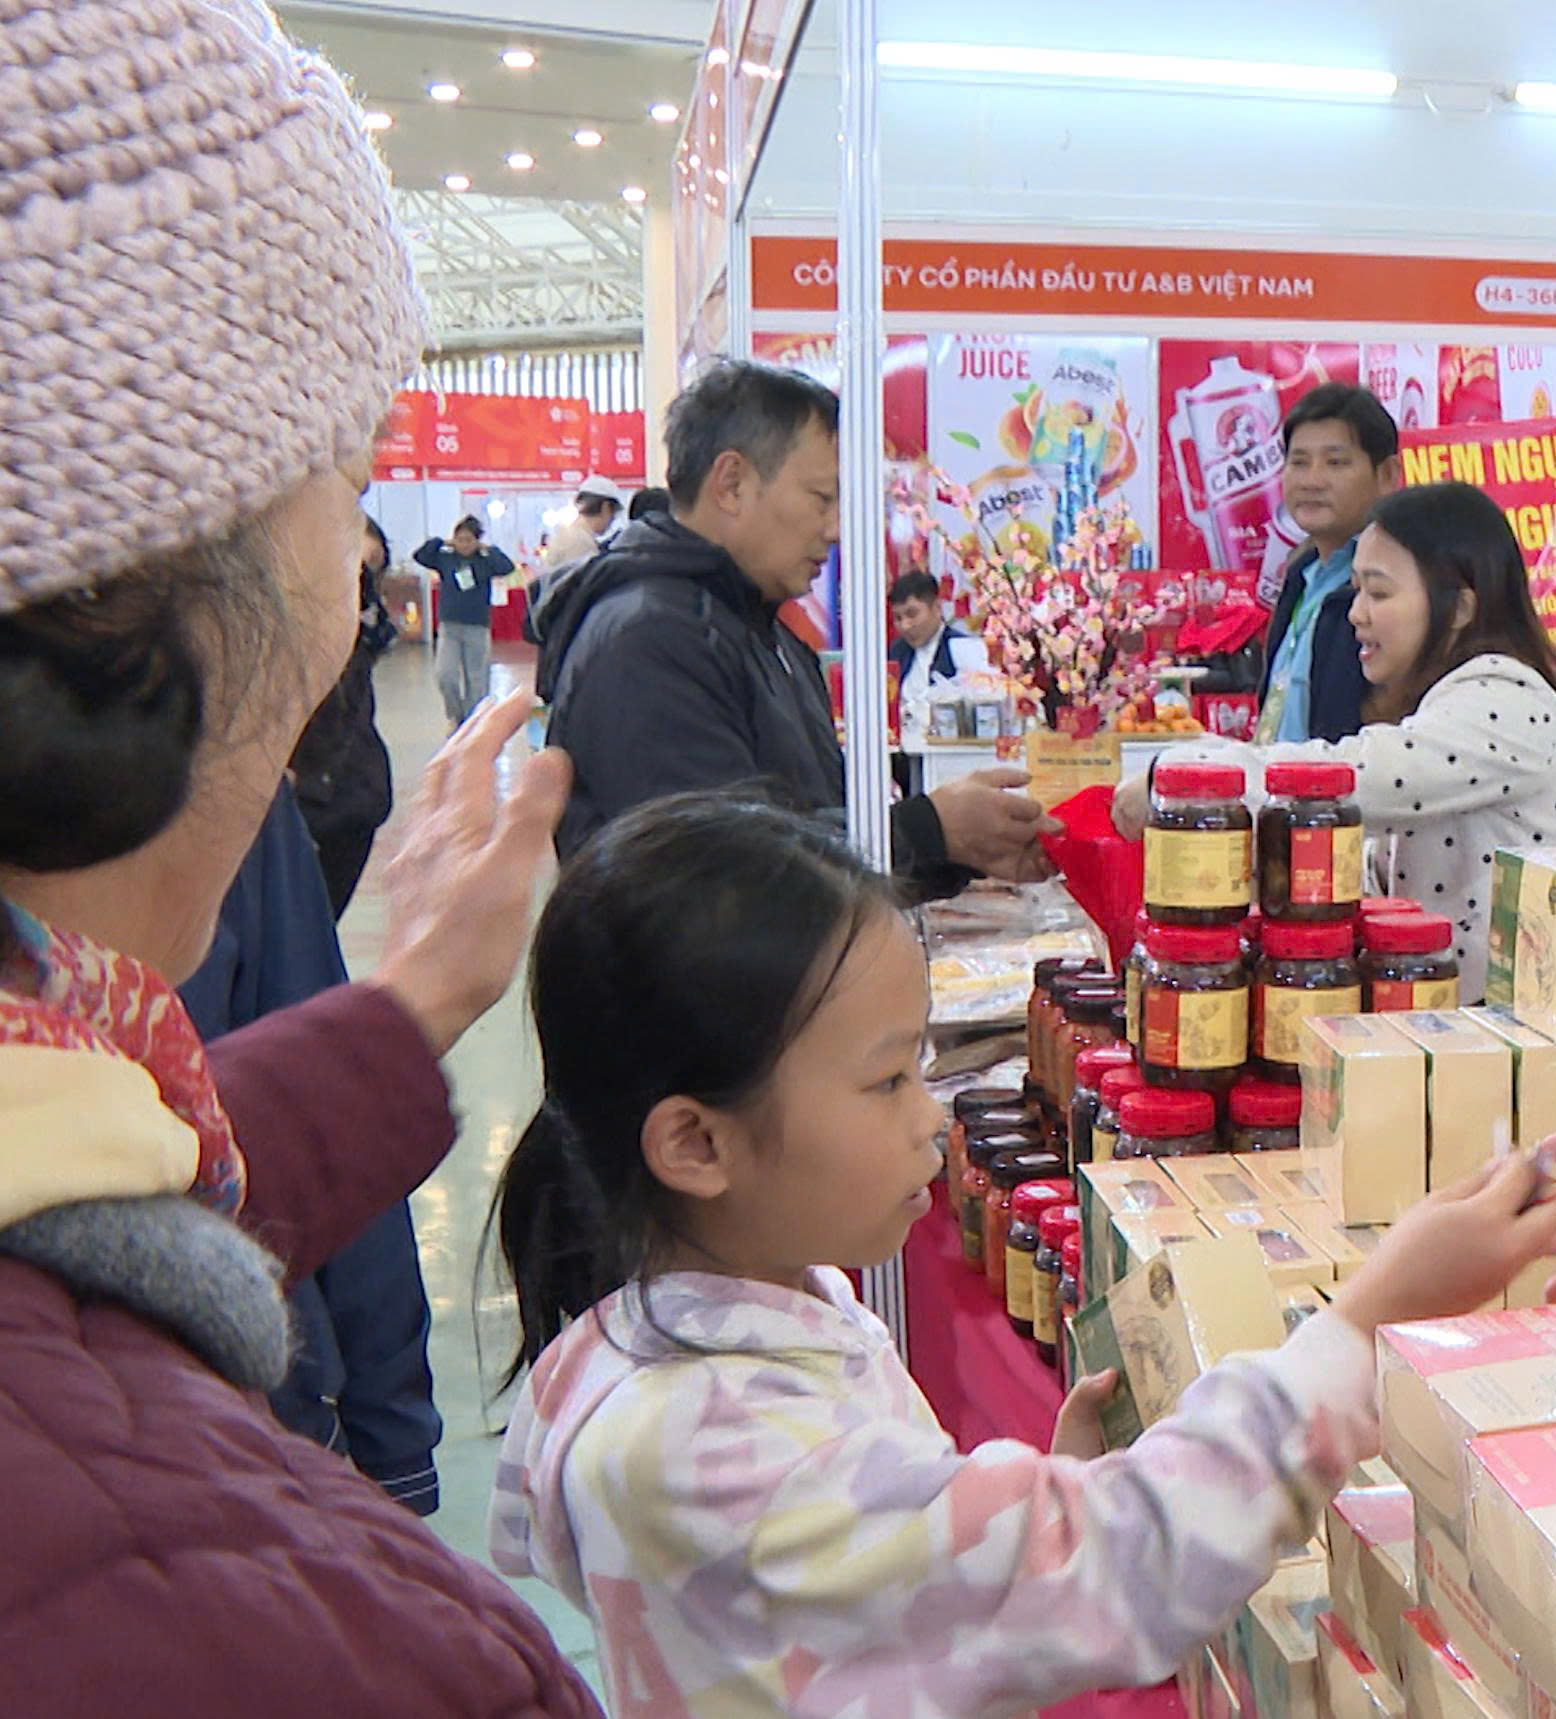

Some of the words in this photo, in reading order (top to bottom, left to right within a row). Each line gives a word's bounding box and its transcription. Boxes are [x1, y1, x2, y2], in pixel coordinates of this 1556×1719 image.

[1140, 270, 1194, 296] A&B
[1198, 268, 1253, 302] VIỆT
[1258, 275, 1314, 299] NAM
[957, 347, 1033, 380] JUICE
[1402, 441, 1486, 488] NEM
